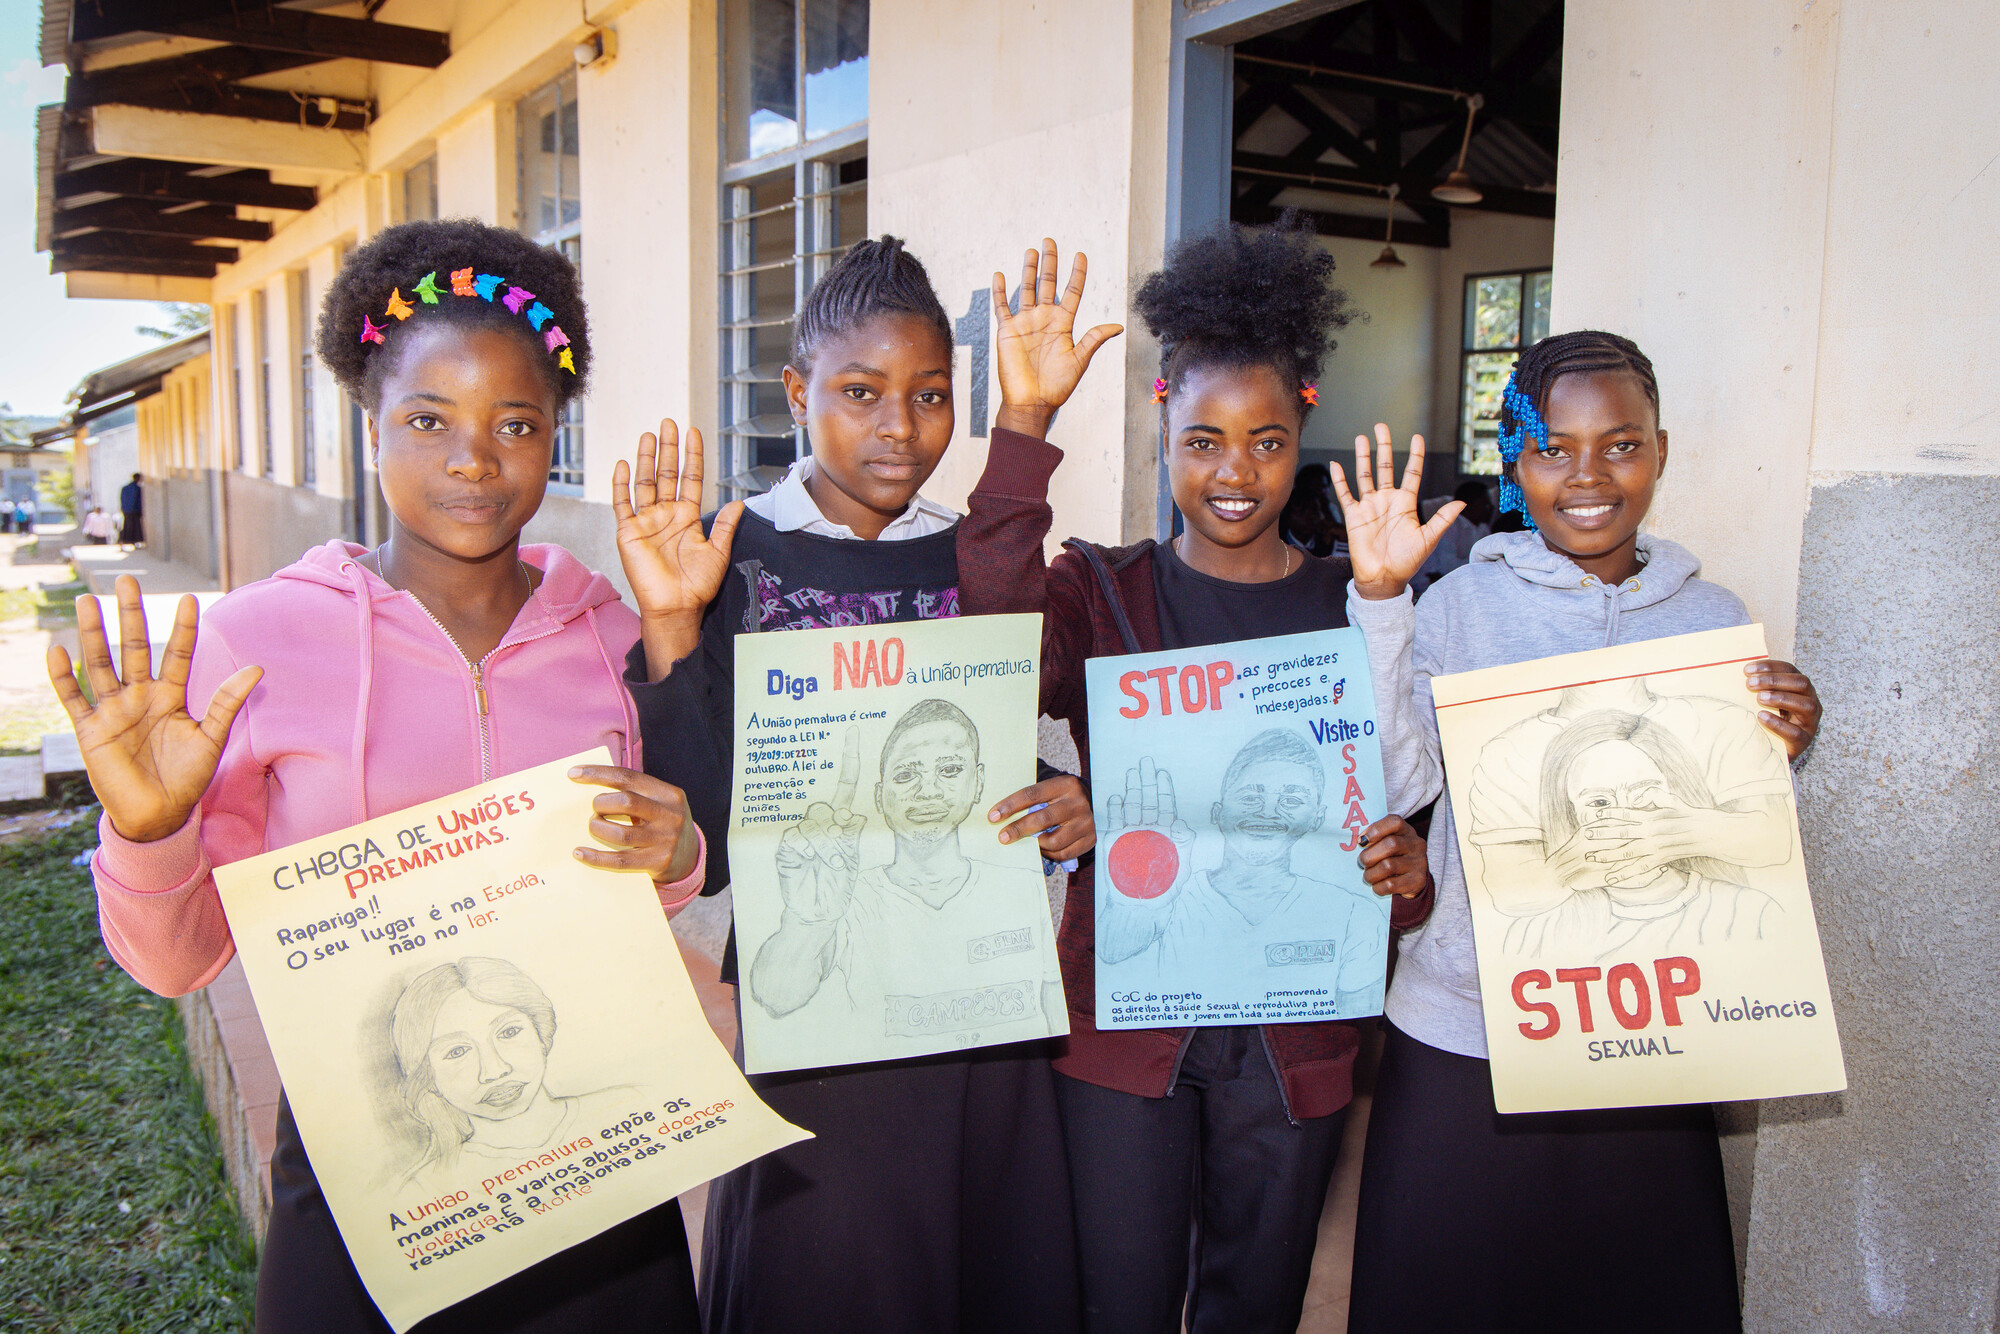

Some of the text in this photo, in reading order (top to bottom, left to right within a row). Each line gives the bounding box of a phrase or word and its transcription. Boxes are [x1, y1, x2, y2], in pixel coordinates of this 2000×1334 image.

[767, 637, 1035, 700] Diga NAO à União prematura.
[1243, 665, 1260, 678] as
[1267, 653, 1339, 679] gravidezes
[1252, 676, 1311, 700] precoces
[747, 710, 887, 729] A União prematura é crime
[1309, 718, 1359, 745] Visite
[746, 735, 787, 749] segundo
[789, 734, 798, 743] a
[800, 732, 815, 742] LEI
[792, 760, 800, 772] A
[802, 760, 816, 771] lei
[820, 760, 834, 770] de
[743, 789, 807, 801] combate às
[744, 777, 804, 793] prevenção
[396, 825, 432, 850] DE
[276, 894, 381, 946] Rapariga!!
[286, 873, 545, 970] O seu lugar é na Escola,
[388, 910, 499, 956] não no lar.
[1298, 943, 1333, 957] PLAN
[1125, 1004, 1160, 1014] direitos
[1173, 1003, 1201, 1011] saúde
[1252, 1000, 1308, 1010] reprodutiva
[1313, 1000, 1335, 1009] para
[1144, 992, 1158, 1001] do
[1161, 991, 1202, 1004] projeto
[1266, 988, 1328, 1000] promovendo
[1511, 956, 1817, 1041] STOP Violência
[1112, 1013, 1178, 1023] adolescentes
[1240, 1010, 1262, 1018] toda
[1588, 1036, 1683, 1061] SEXUAL
[389, 1212, 407, 1231] A
[600, 1111, 656, 1140] expõe
[663, 1097, 691, 1114] as
[525, 1195, 541, 1209] a
[552, 1157, 631, 1195] maioria
[634, 1141, 666, 1160] das
[671, 1115, 727, 1143] vezes
[397, 1202, 490, 1247] meninas
[496, 1192, 512, 1204] a
[516, 1163, 580, 1195] varios
[582, 1134, 651, 1167] abusos
[409, 1184, 593, 1271] resulta na Morte
